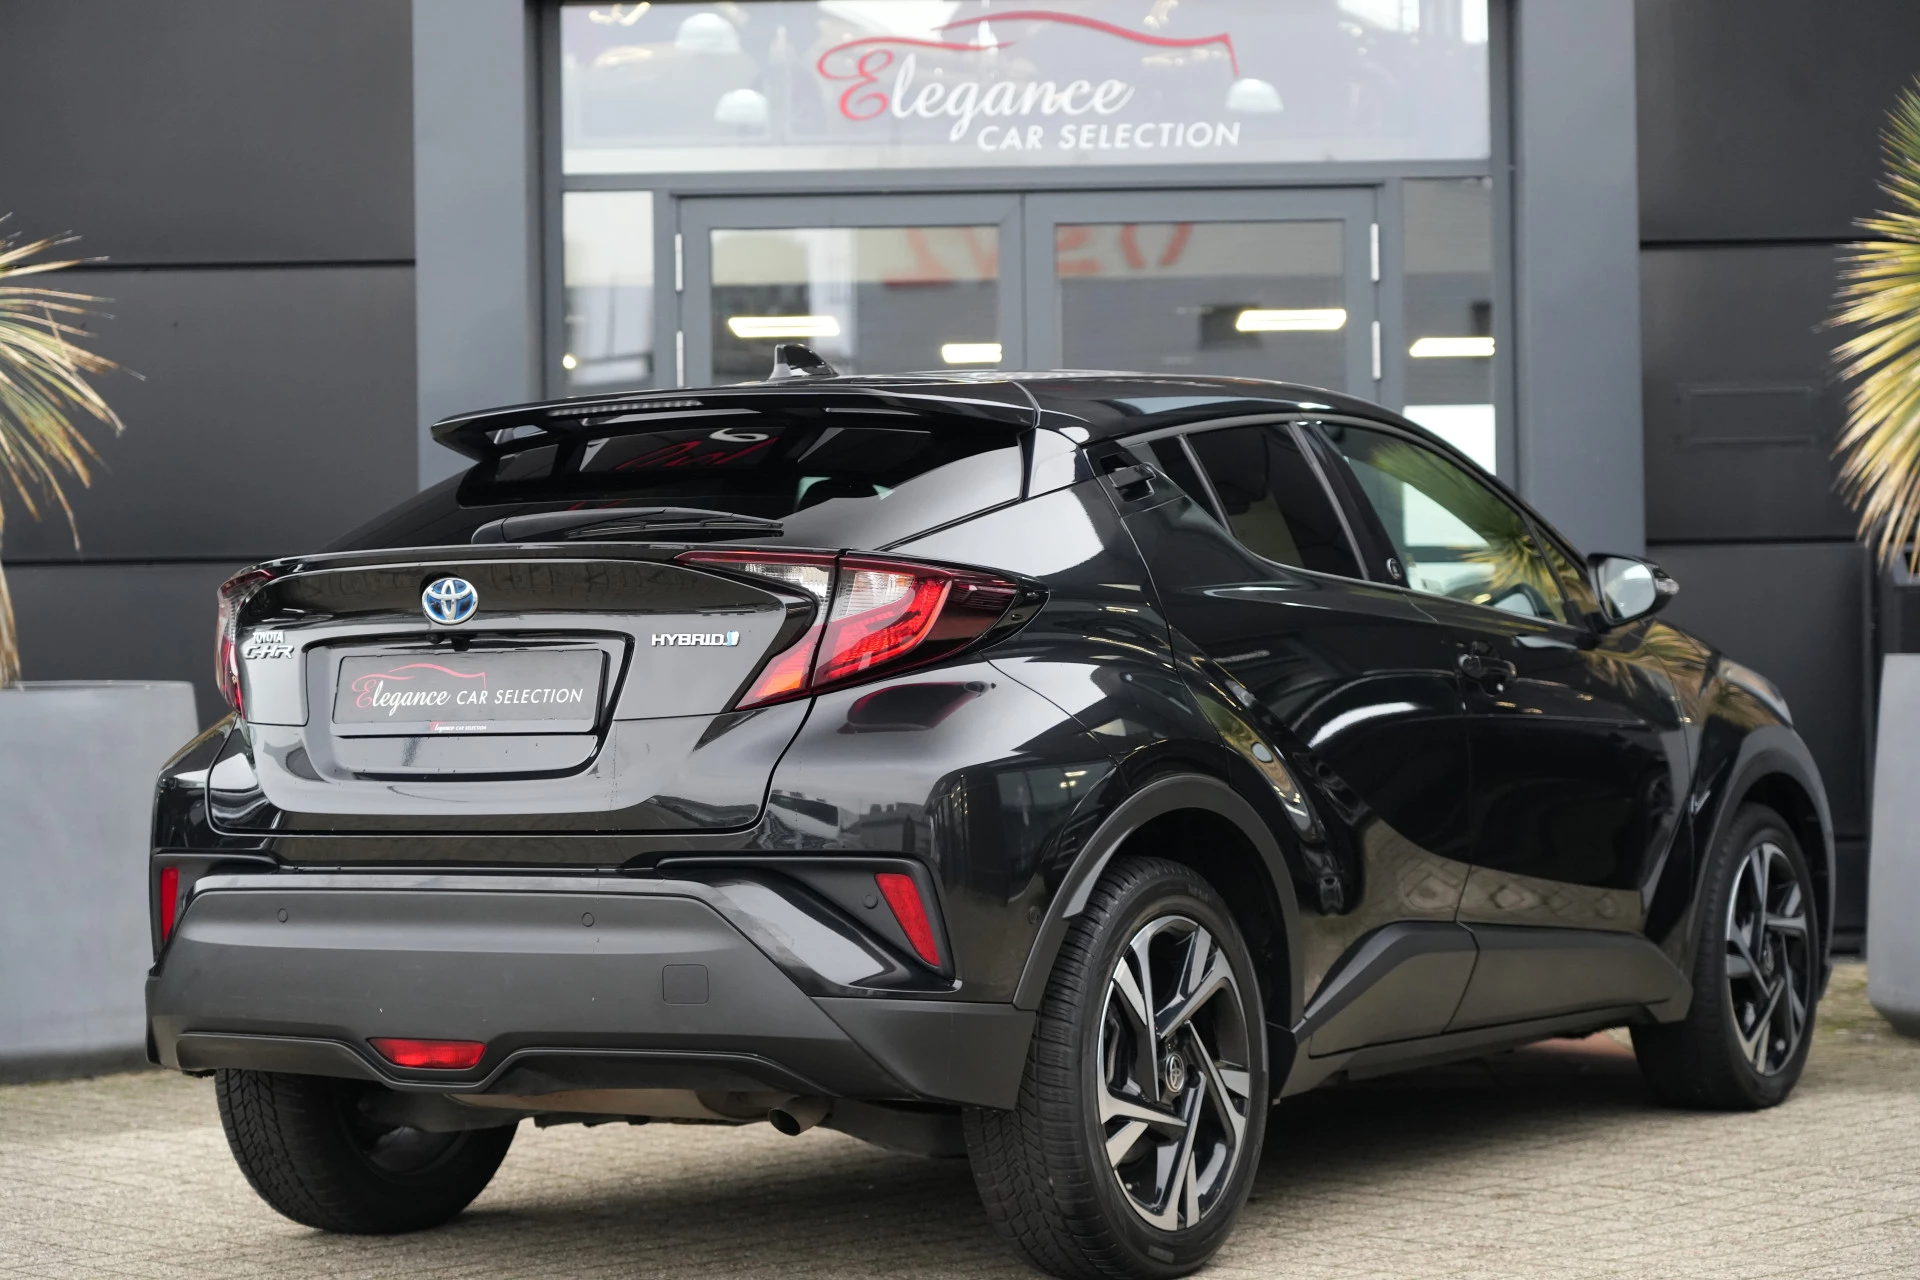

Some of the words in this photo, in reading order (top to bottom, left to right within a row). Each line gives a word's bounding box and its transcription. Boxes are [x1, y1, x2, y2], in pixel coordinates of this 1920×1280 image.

[817, 40, 1135, 142] Elegance
[977, 126, 1042, 151] CAR
[1060, 122, 1241, 149] SELECTION
[253, 631, 285, 643] TOYOTA
[651, 633, 725, 647] HYBRID
[352, 678, 451, 716] Elegance
[456, 690, 488, 705] CAR
[494, 688, 584, 704] SELECTION
